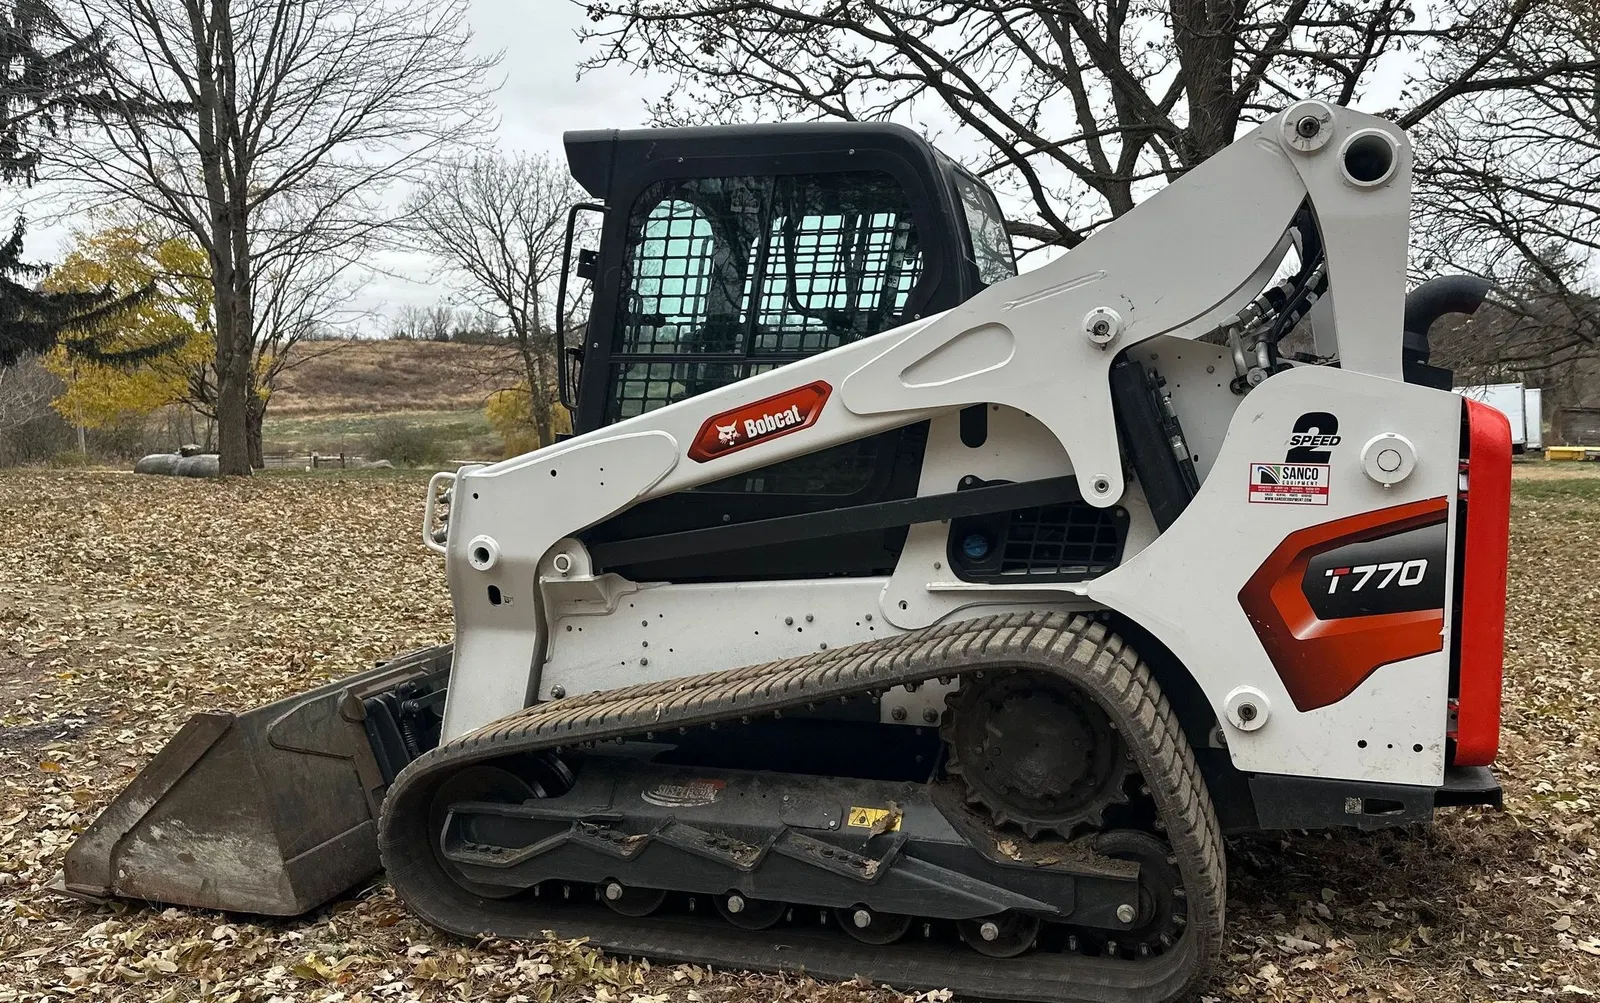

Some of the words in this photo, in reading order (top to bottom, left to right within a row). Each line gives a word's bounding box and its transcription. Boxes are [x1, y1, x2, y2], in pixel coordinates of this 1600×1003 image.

[744, 404, 802, 438] Bobcat
[1285, 411, 1339, 464] 2
[1290, 435, 1341, 446] SPEED
[1282, 466, 1319, 480] SANCO
[1325, 559, 1428, 594] T770
